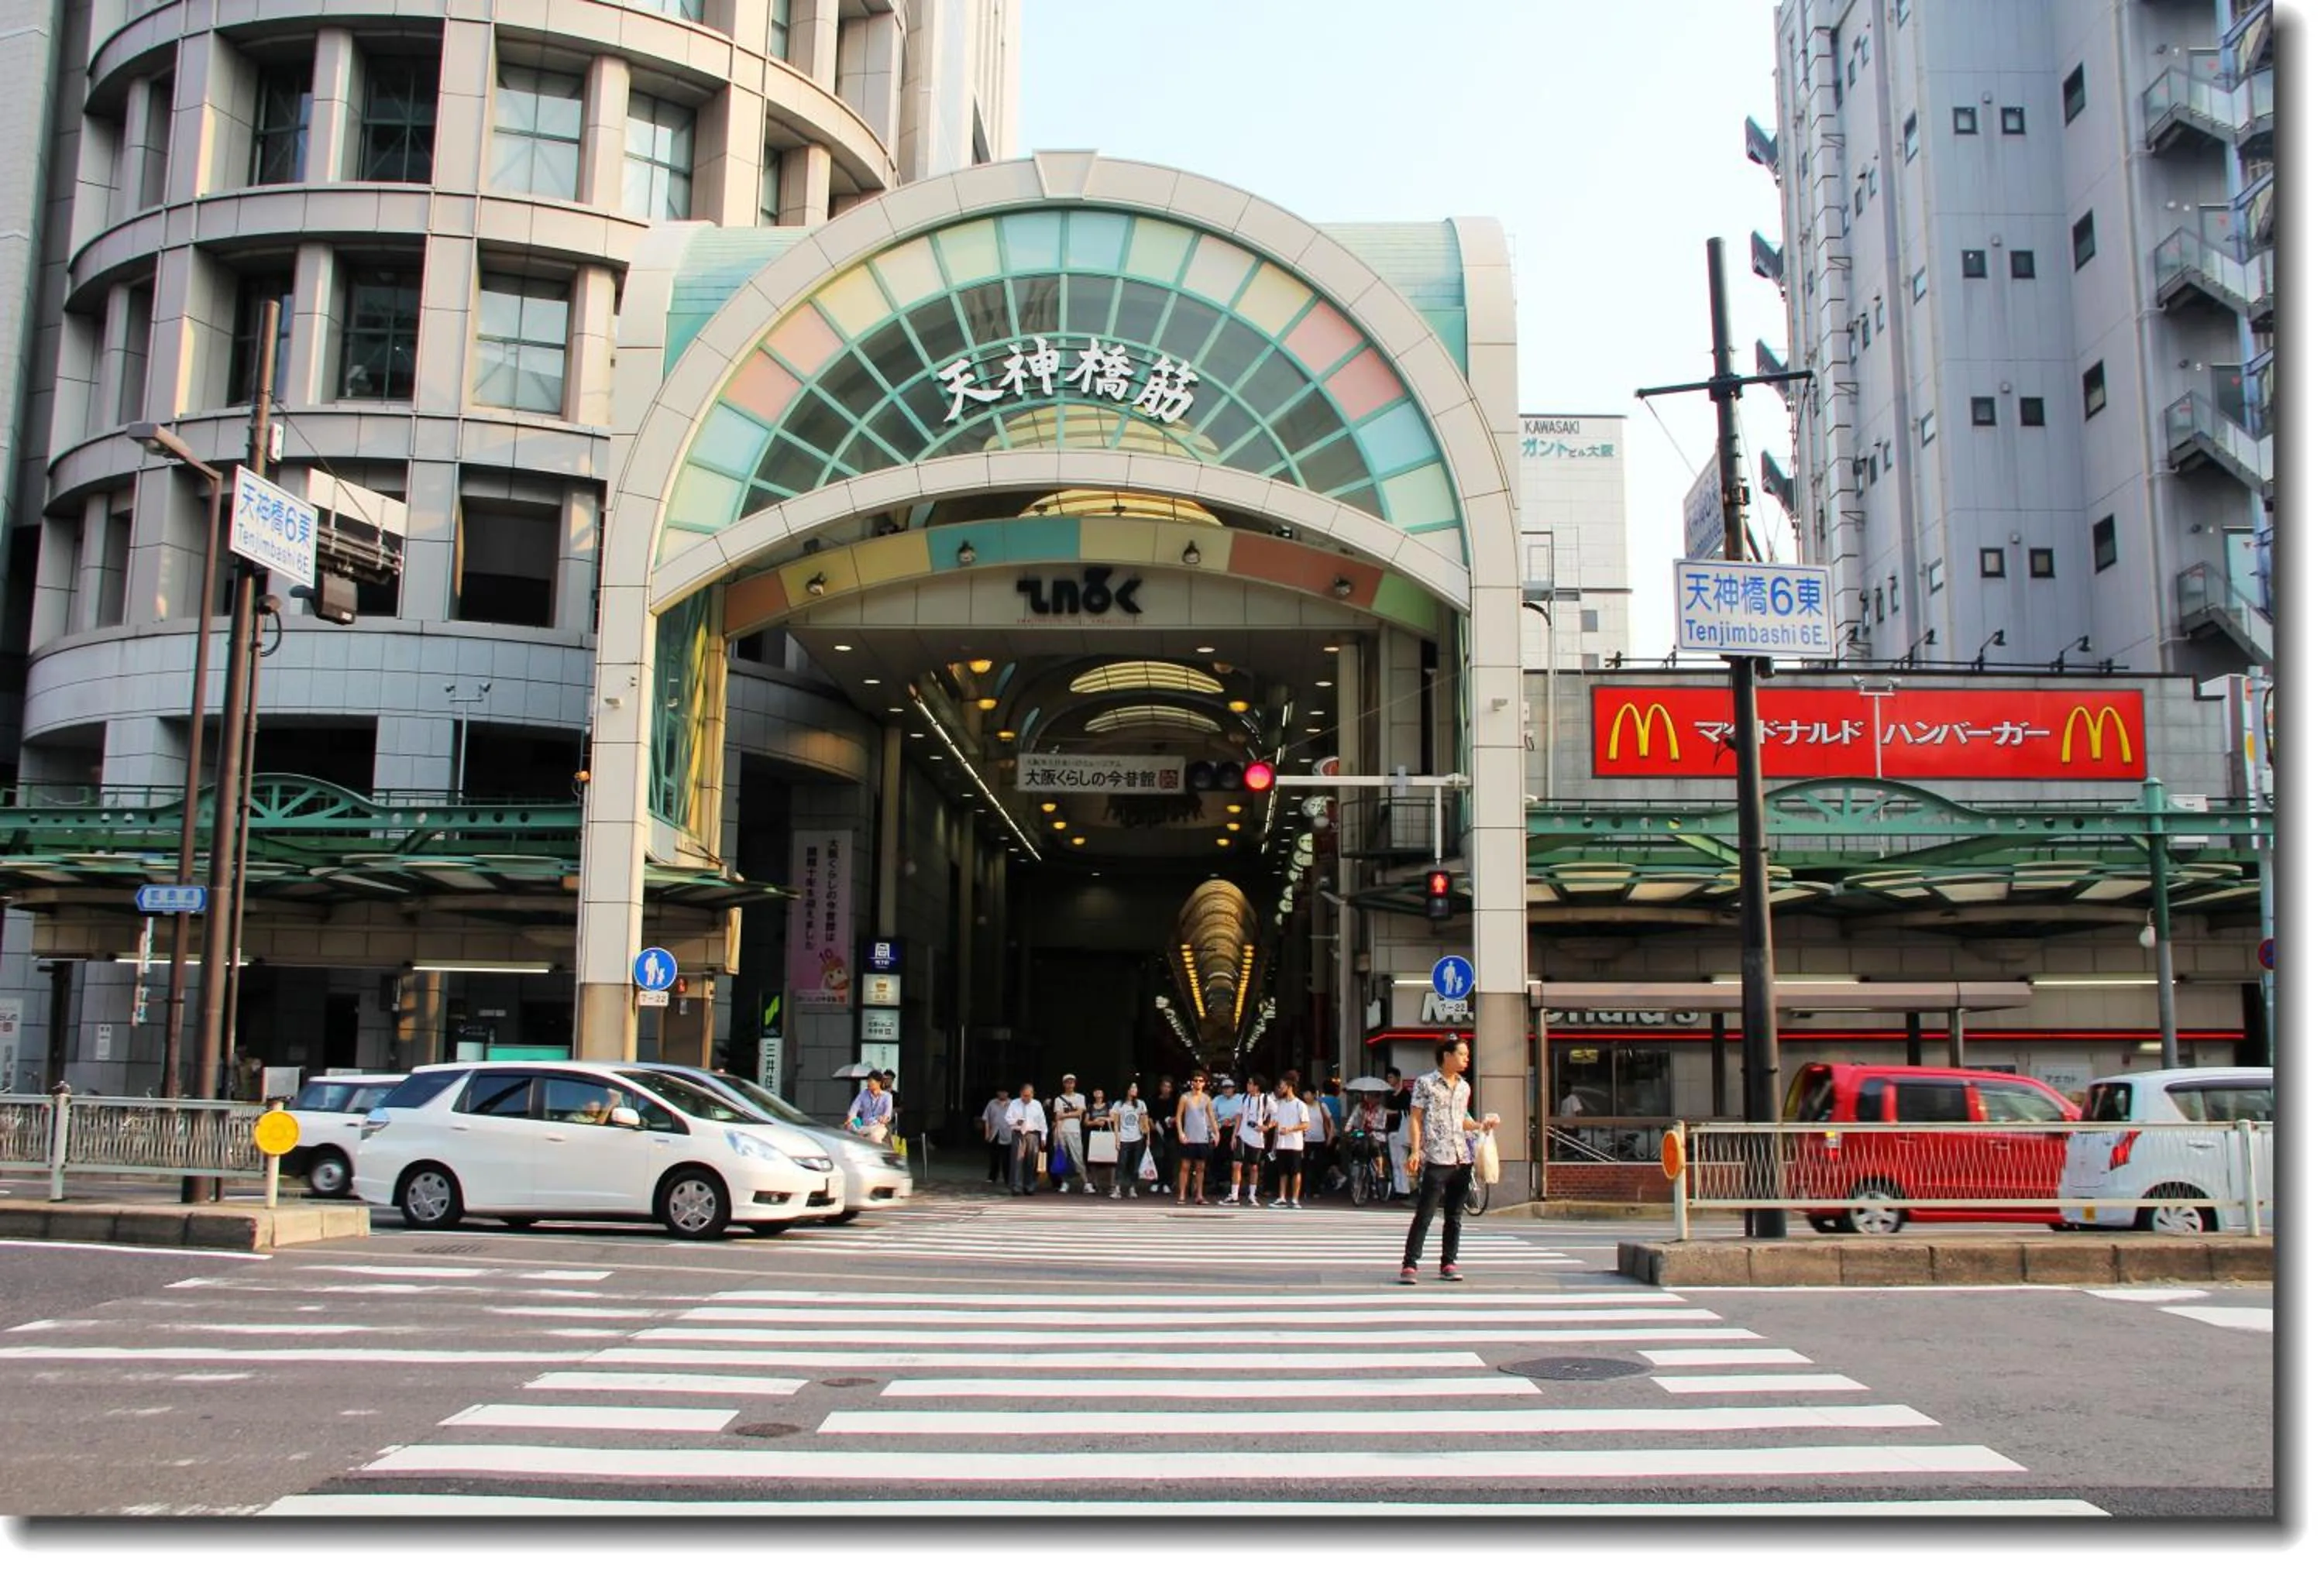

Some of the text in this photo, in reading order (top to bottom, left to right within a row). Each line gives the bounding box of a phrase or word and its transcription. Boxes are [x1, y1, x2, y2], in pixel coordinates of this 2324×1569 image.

[938, 335, 1199, 424] 天神橋筋
[1524, 420, 1580, 434] KAWASAKI
[239, 482, 313, 550] 天神橋6東
[1684, 572, 1824, 617] 天神橋6東
[1684, 619, 1797, 646] Tenjimbashi
[1693, 719, 2051, 747] マドナルド ハンバーガー
[1025, 769, 1156, 788] 大阪くらしの今昔館
[1441, 1003, 1466, 1012] 7-22
[765, 1042, 776, 1094] 三井住
